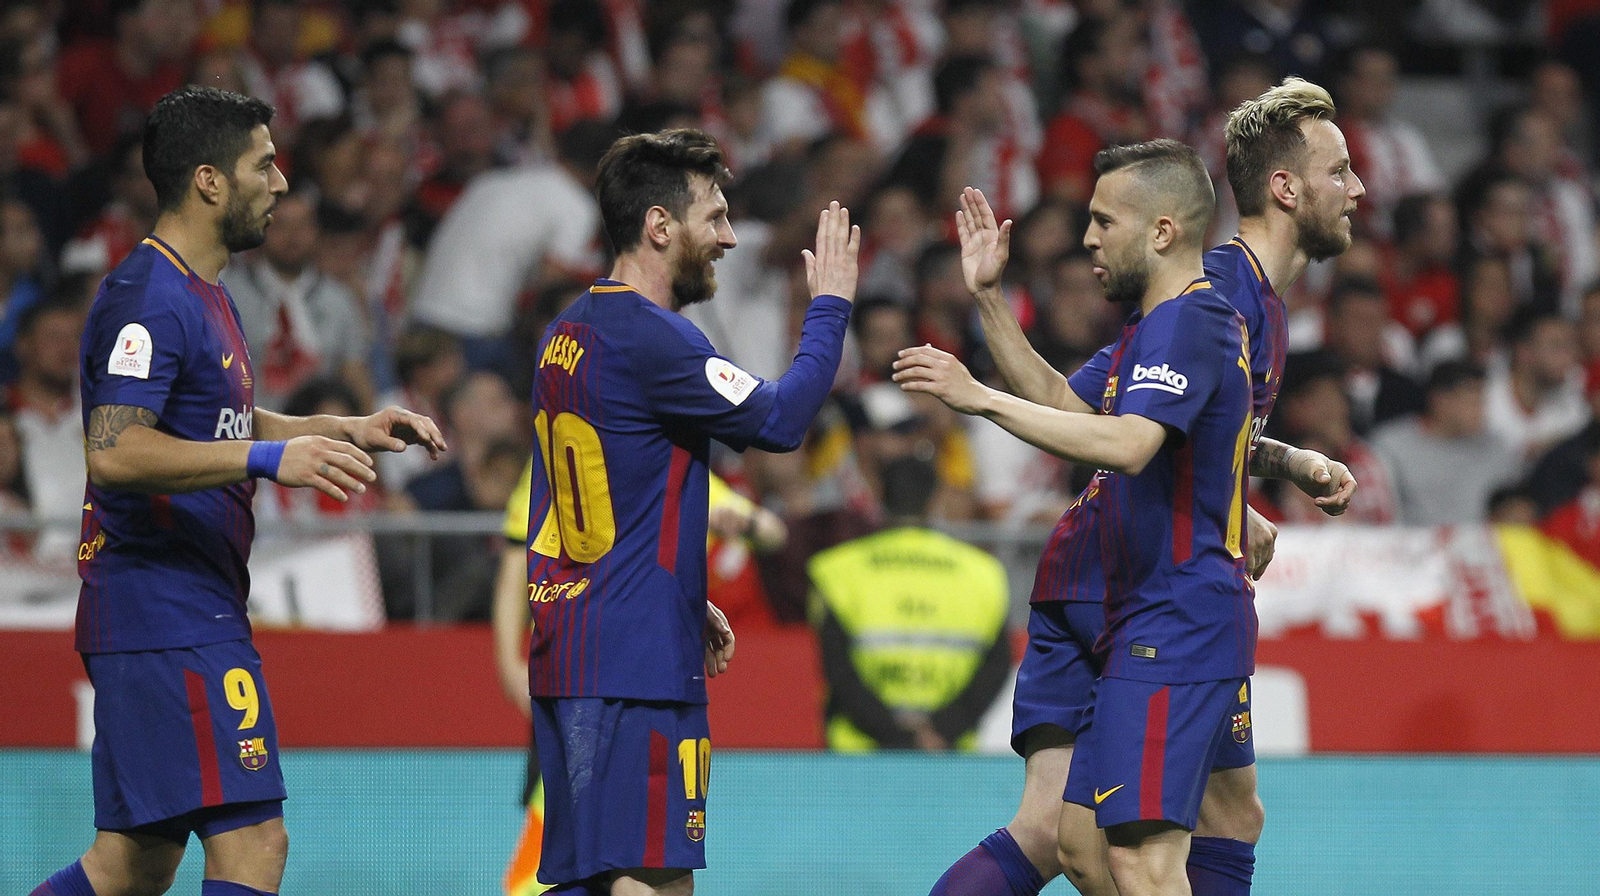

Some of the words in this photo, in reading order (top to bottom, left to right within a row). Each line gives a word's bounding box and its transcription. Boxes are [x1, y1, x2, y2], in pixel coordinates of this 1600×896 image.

[539, 333, 584, 376] MESSI
[1132, 363, 1188, 390] beko
[529, 408, 616, 564] 10
[223, 667, 260, 731] 9
[678, 737, 712, 800] 10
